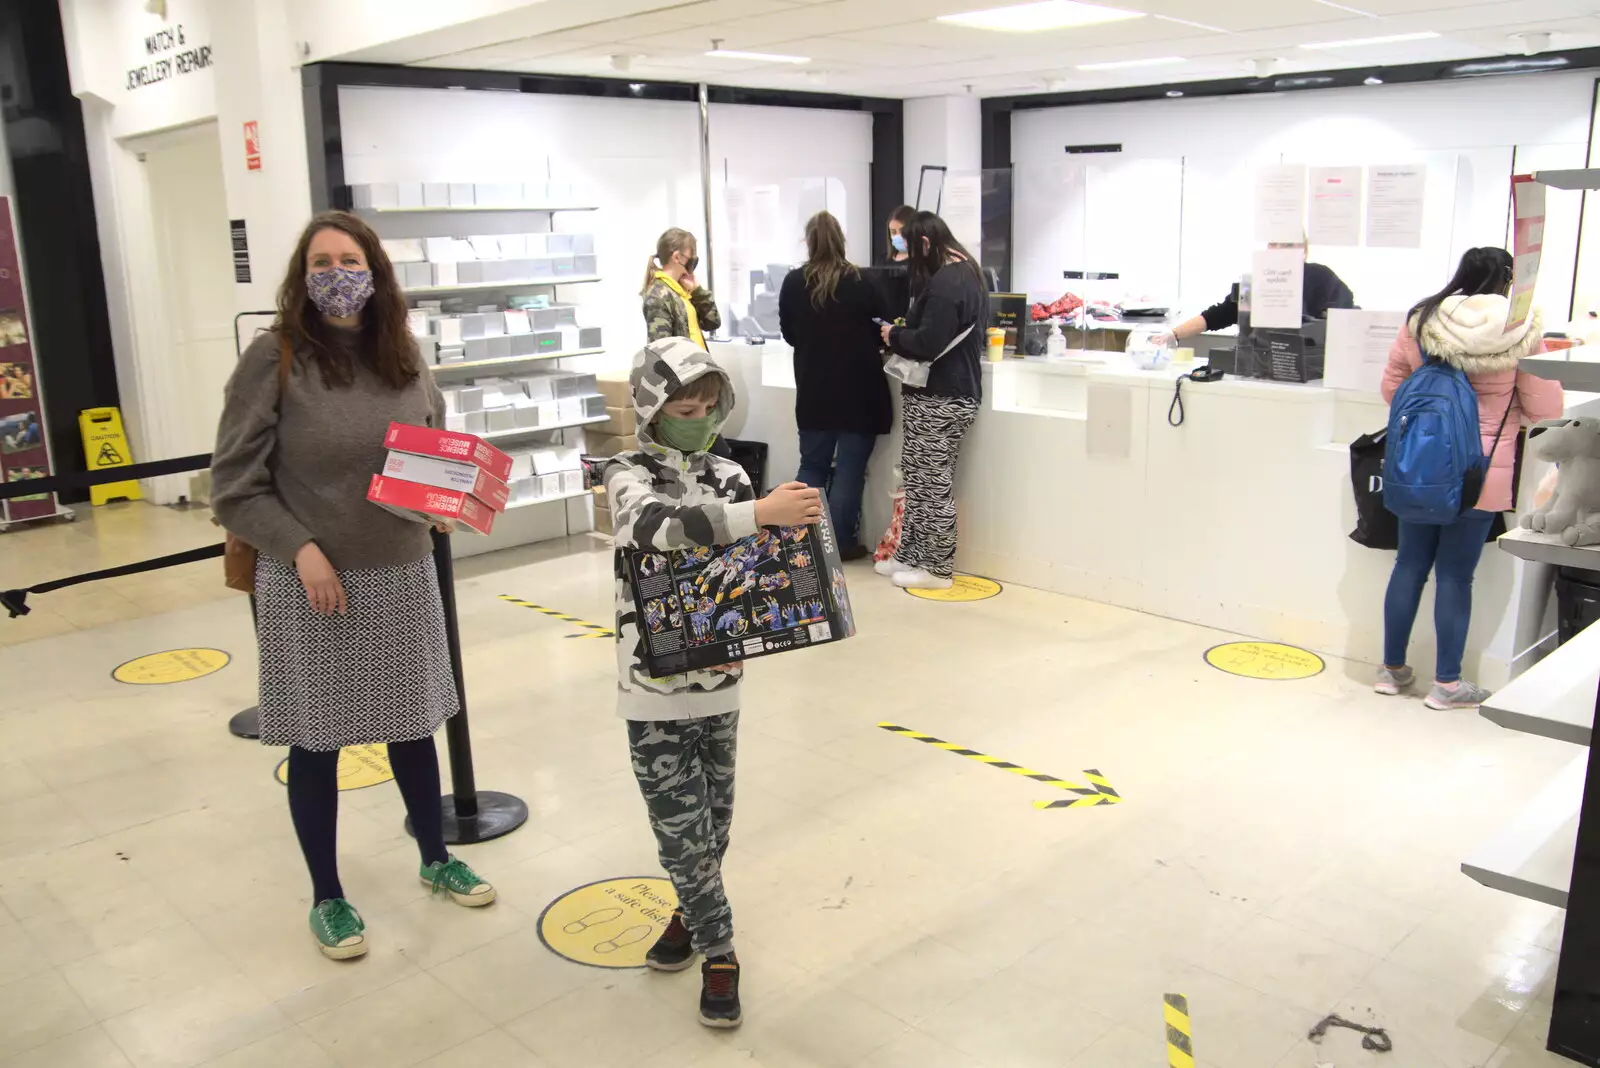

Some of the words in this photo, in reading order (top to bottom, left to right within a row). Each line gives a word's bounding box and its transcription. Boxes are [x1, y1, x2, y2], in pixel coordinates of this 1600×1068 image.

[144, 28, 175, 54] WATCH
[178, 24, 185, 45] &
[126, 57, 172, 91] JEWELLERY
[438, 437, 471, 449] MUSEUM
[439, 444, 468, 456] SCIENCE
[426, 492, 460, 505] MUSEUM
[426, 500, 458, 512] SCIENCE
[614, 891, 642, 909] safe
[630, 883, 672, 908] Please
